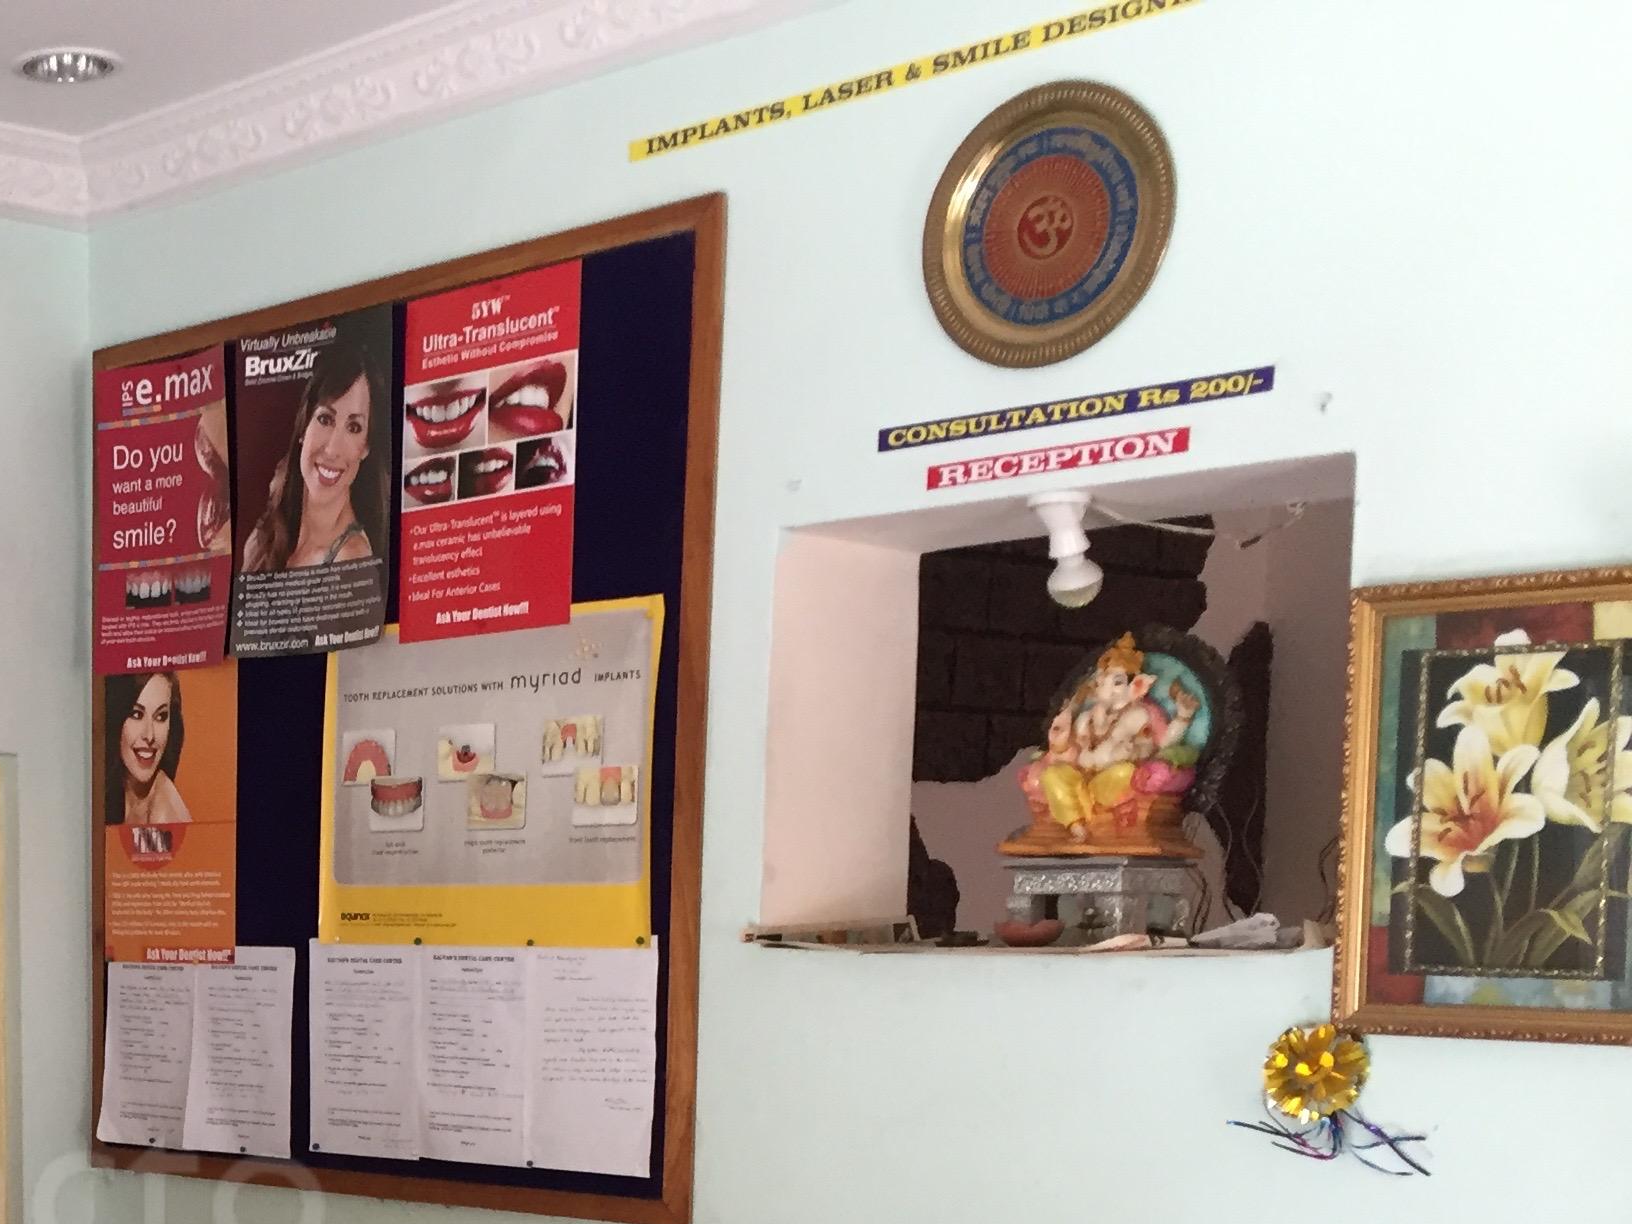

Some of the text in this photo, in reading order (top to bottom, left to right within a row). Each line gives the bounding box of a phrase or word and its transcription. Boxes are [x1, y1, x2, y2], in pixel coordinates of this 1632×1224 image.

[646, 101, 791, 155] IMPLANTS,
[803, 70, 896, 112] LASER
[905, 62, 922, 82] &
[932, 30, 1031, 75] SMILE
[240, 335, 280, 352] Virtually
[422, 330, 559, 369] Esthetic Without Compromise
[245, 348, 318, 377] BruxZir
[121, 380, 134, 407] IPS
[135, 364, 213, 406] e.max
[887, 372, 1264, 448] CONSULTATION Rs 200/-
[113, 443, 183, 473] Do you
[937, 431, 1179, 488] RECEPTION
[112, 474, 183, 495] want a more
[112, 496, 163, 516] beautiful
[509, 506, 538, 522] layered
[539, 504, 562, 516] using
[113, 518, 177, 549] smile?
[436, 611, 451, 624] Ask
[452, 608, 472, 622] Your
[472, 607, 502, 620] Dentist
[315, 634, 328, 646] Ask
[126, 657, 142, 669] Ask
[143, 656, 161, 668] Your
[344, 668, 641, 703] TOOTH REPLACEMENT SOLUTIONS WITH myriad IMPLANTS
[146, 948, 160, 960] Ask
[161, 949, 178, 960] Your
[179, 949, 206, 961] Dentist
